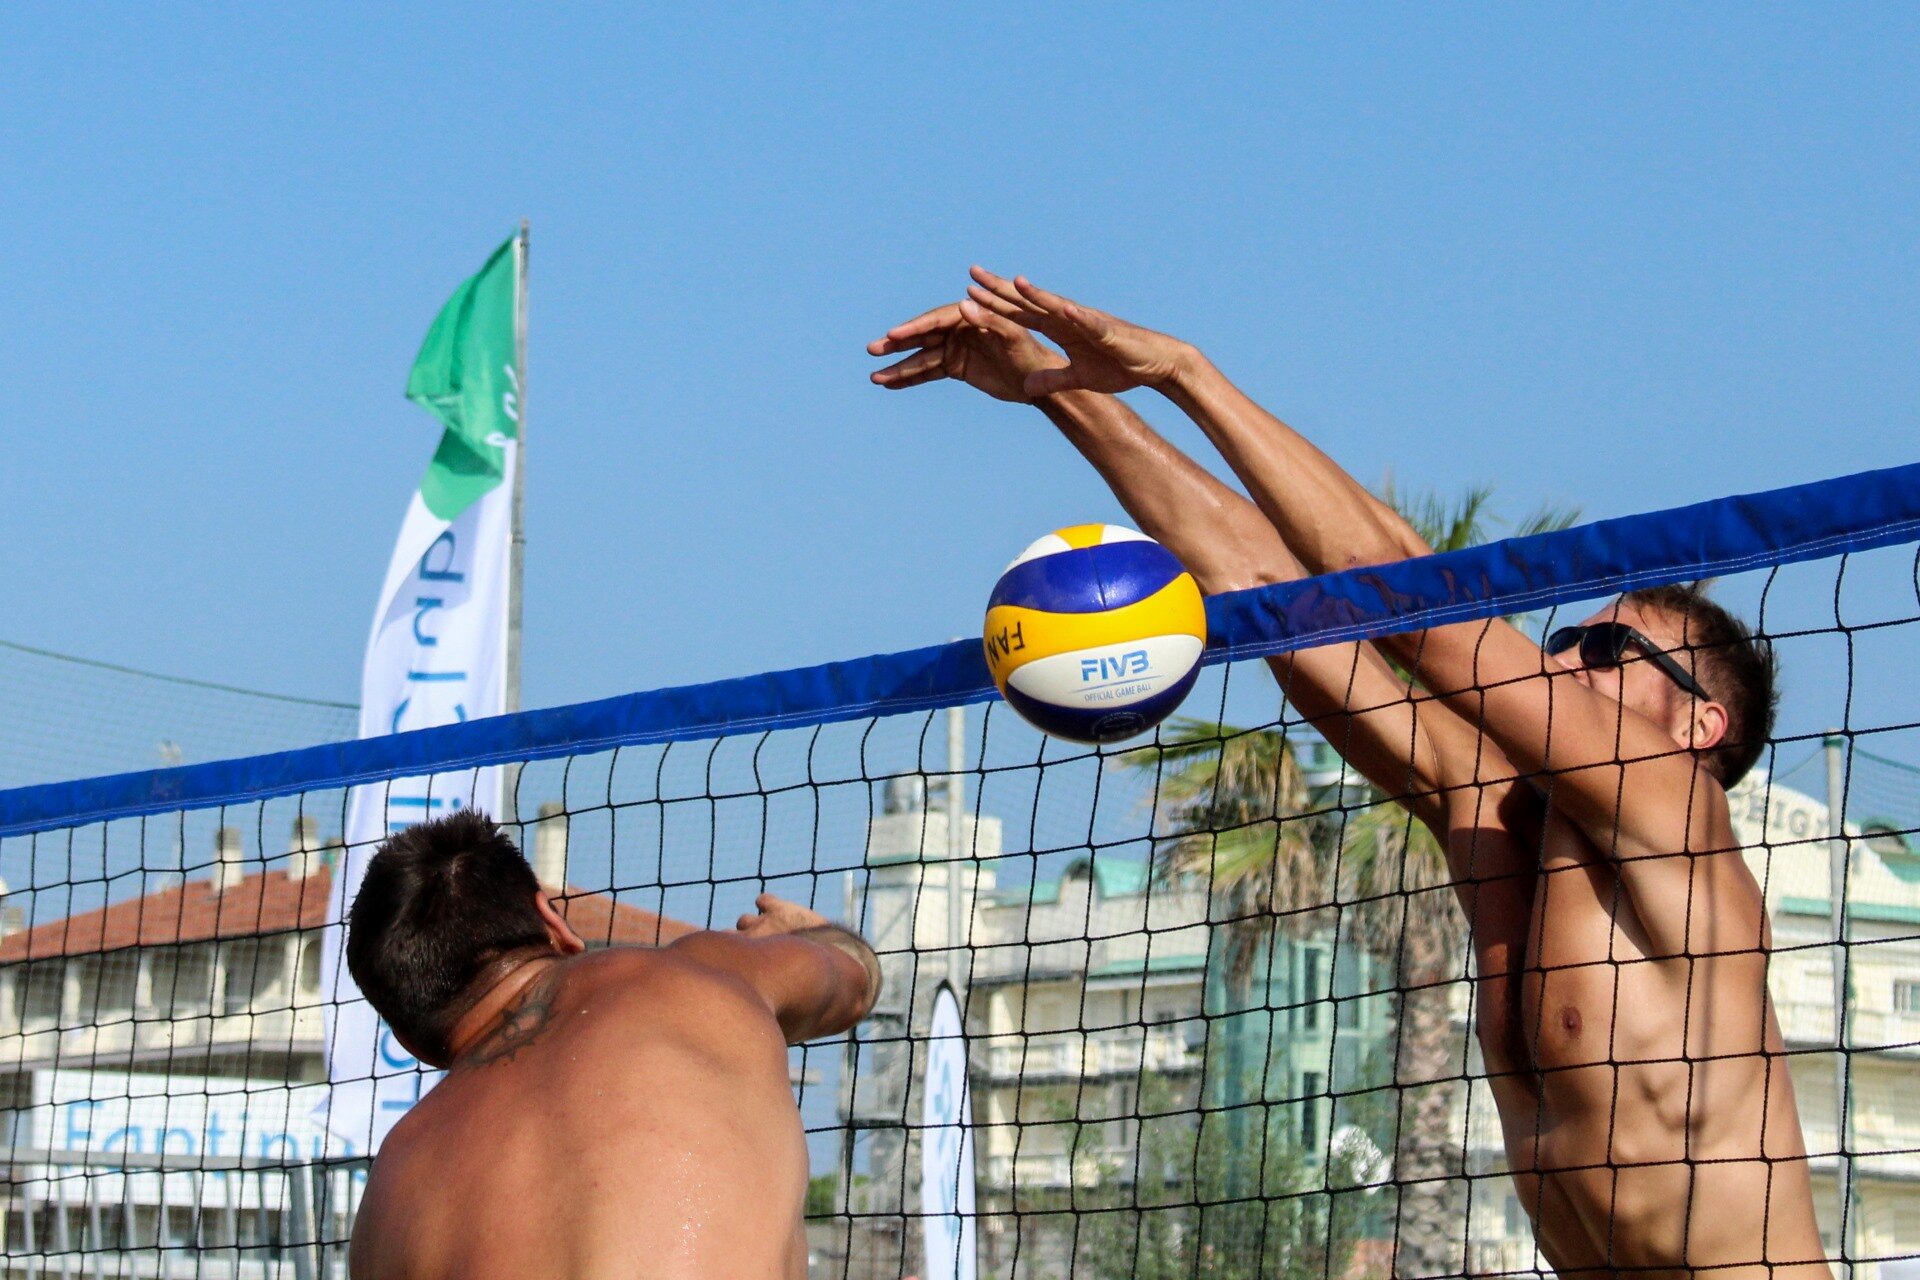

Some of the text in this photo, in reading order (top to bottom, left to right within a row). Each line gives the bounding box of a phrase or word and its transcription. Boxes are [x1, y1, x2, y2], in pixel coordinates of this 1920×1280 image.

[987, 621, 1025, 668] FAN
[1081, 649, 1150, 682] FIVB
[1084, 684, 1152, 701] OFFICIAL GAME BALL
